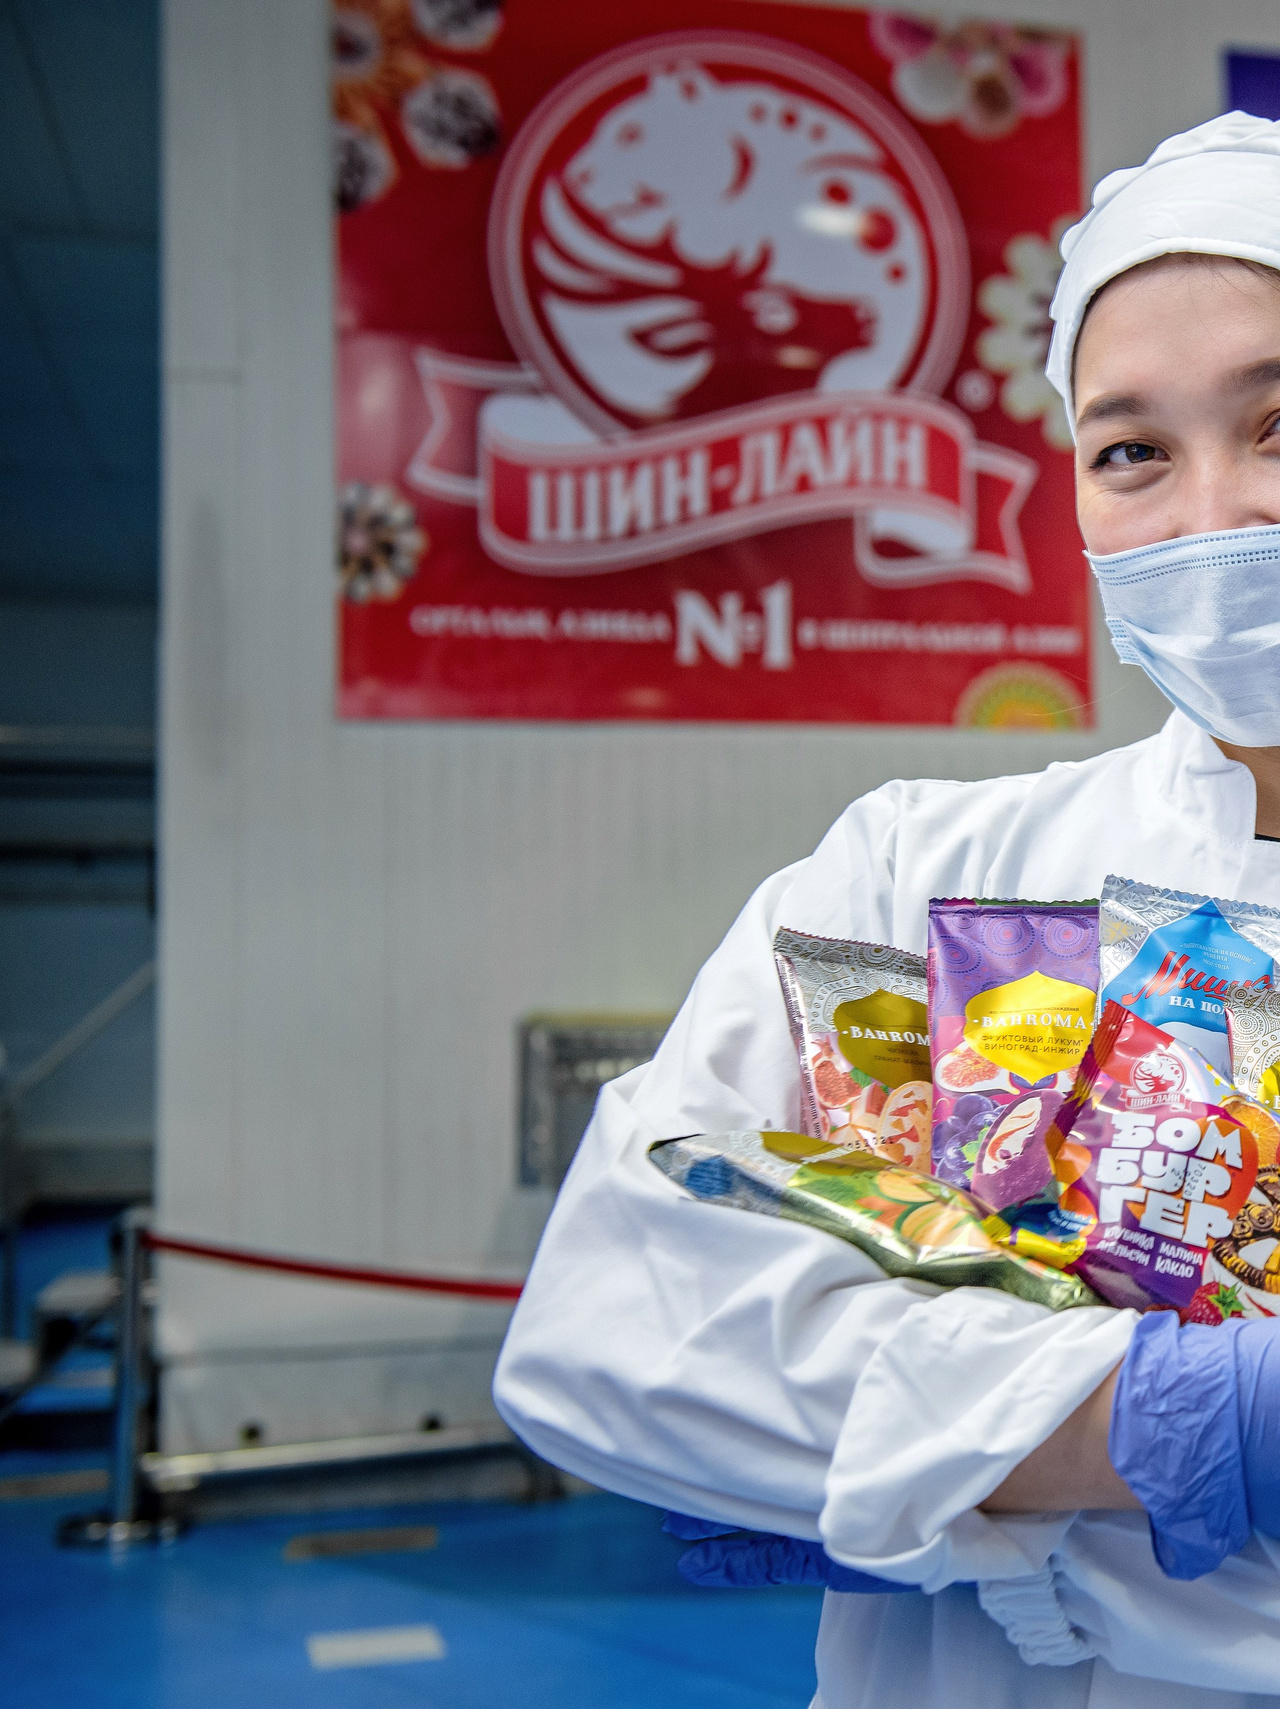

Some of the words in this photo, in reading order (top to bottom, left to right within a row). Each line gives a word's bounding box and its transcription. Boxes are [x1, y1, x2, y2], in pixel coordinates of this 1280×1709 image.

[530, 414, 928, 542] ШИН-ЛАЙН
[1121, 950, 1274, 1006] Мишк
[1169, 995, 1195, 1009] НА
[981, 1013, 1088, 1030] BAHROMA
[849, 1025, 931, 1047] BAHROM
[984, 1043, 1081, 1056] ВИНОГРАД-ИНЖИР
[1130, 1094, 1181, 1107] ШИН-ЛАЙН
[1111, 1113, 1243, 1169] БОМ
[1096, 1148, 1231, 1202] БУР
[1101, 1185, 1233, 1248] ГЕР
[1160, 1241, 1204, 1266] МАЛИНА
[1155, 1256, 1195, 1278] КАКАО
